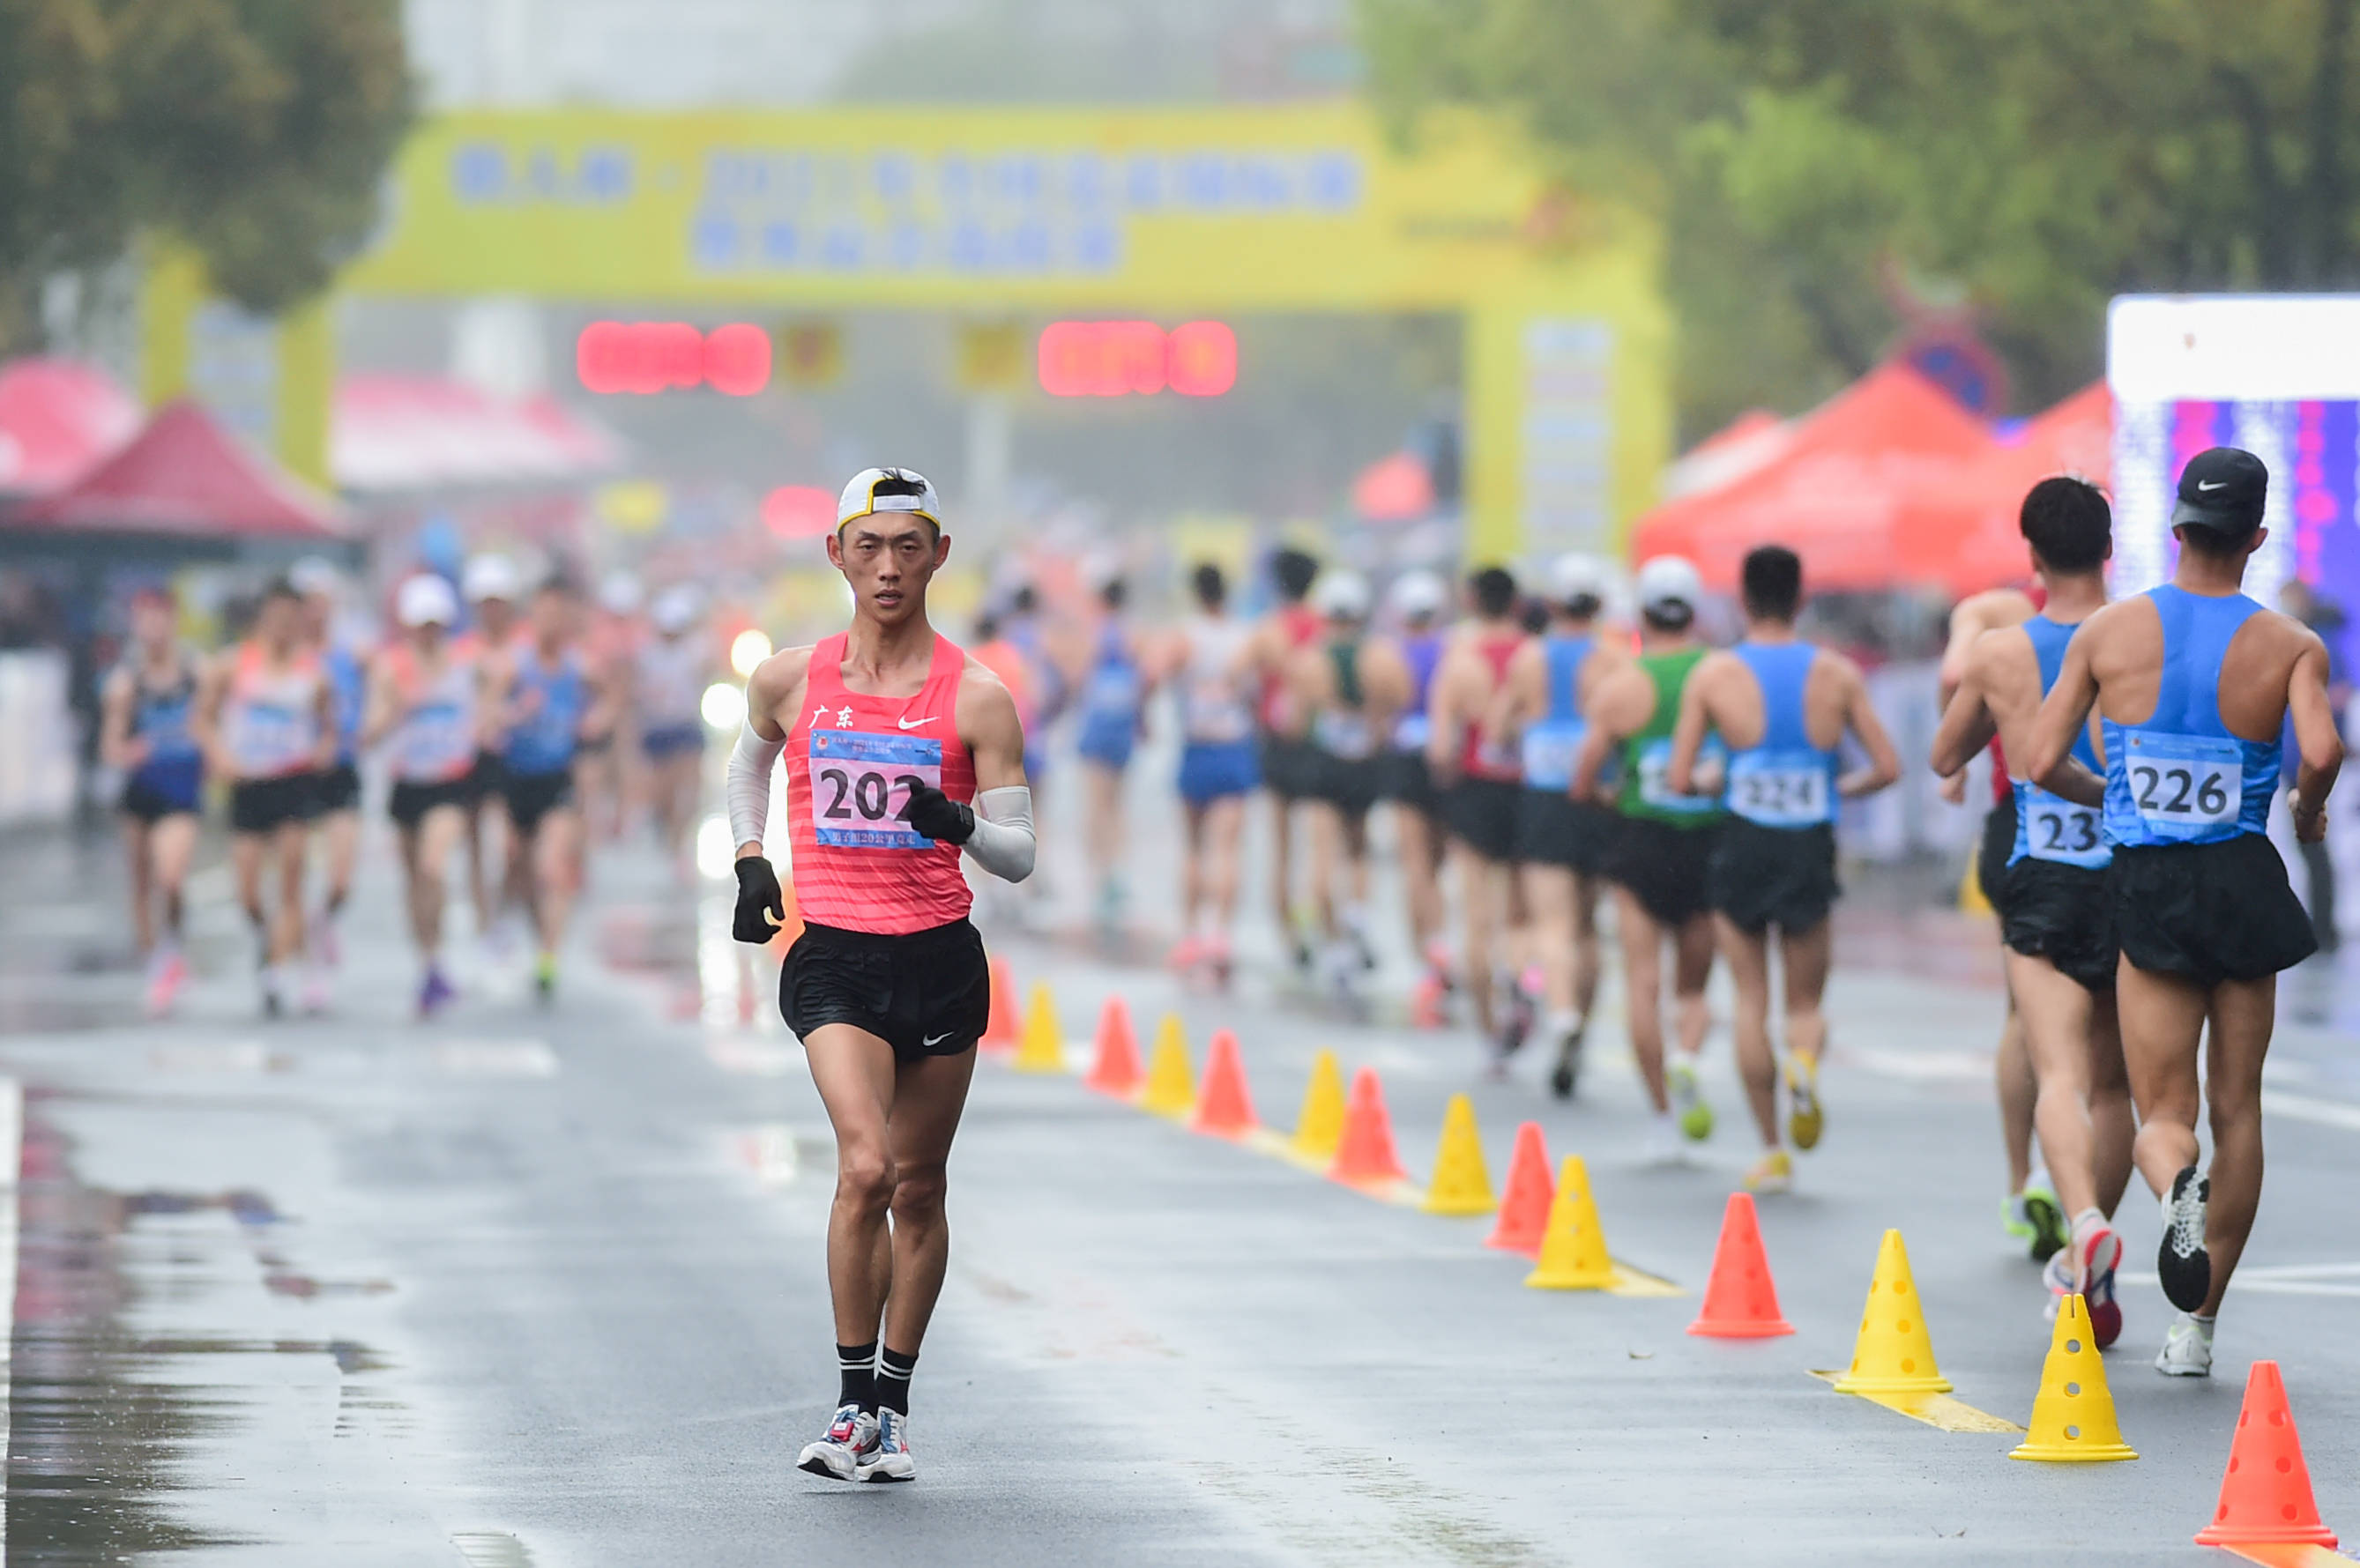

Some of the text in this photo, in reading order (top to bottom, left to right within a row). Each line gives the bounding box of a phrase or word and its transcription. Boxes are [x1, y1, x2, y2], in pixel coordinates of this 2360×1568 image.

[808, 705, 853, 729] 广东
[820, 768, 925, 822] 202
[2133, 765, 2227, 815] 226
[2037, 811, 2103, 852] 23
